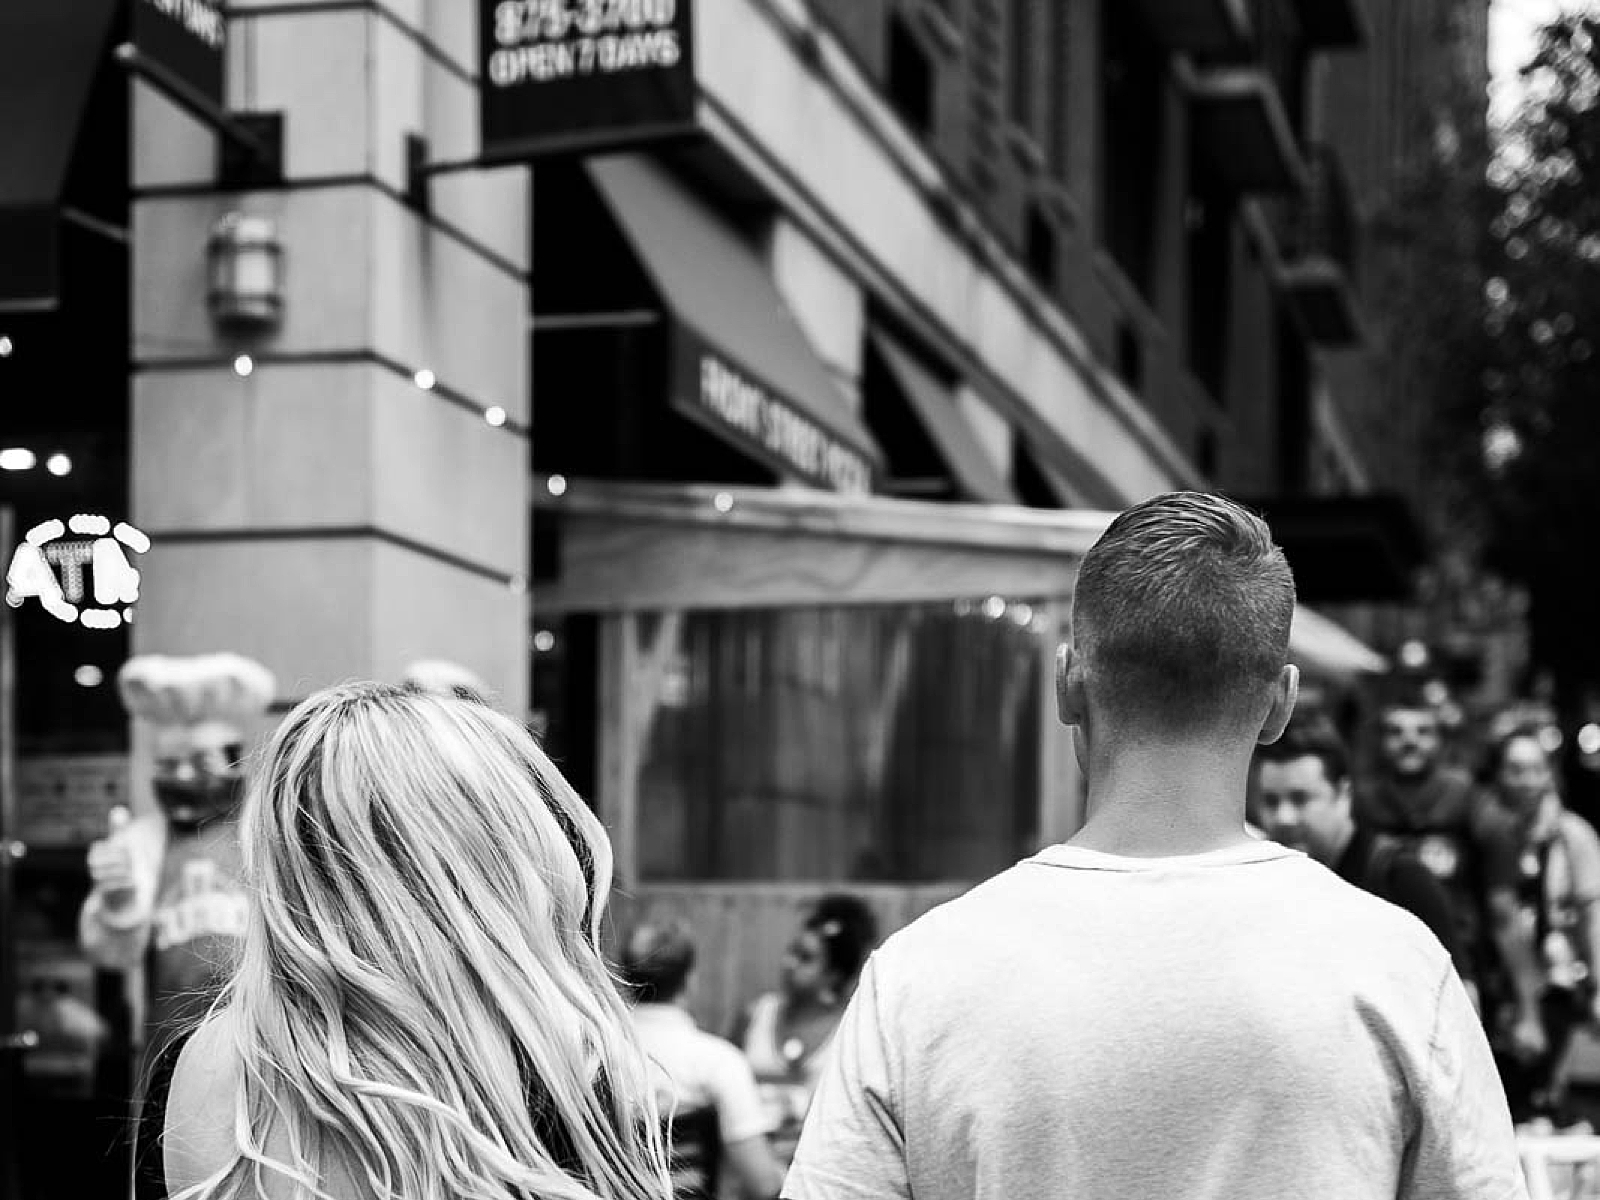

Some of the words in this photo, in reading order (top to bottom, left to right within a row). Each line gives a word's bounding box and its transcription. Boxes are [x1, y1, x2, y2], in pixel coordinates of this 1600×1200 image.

[488, 42, 575, 88] OPEN
[577, 36, 597, 77] 7
[598, 28, 681, 75] DAYS
